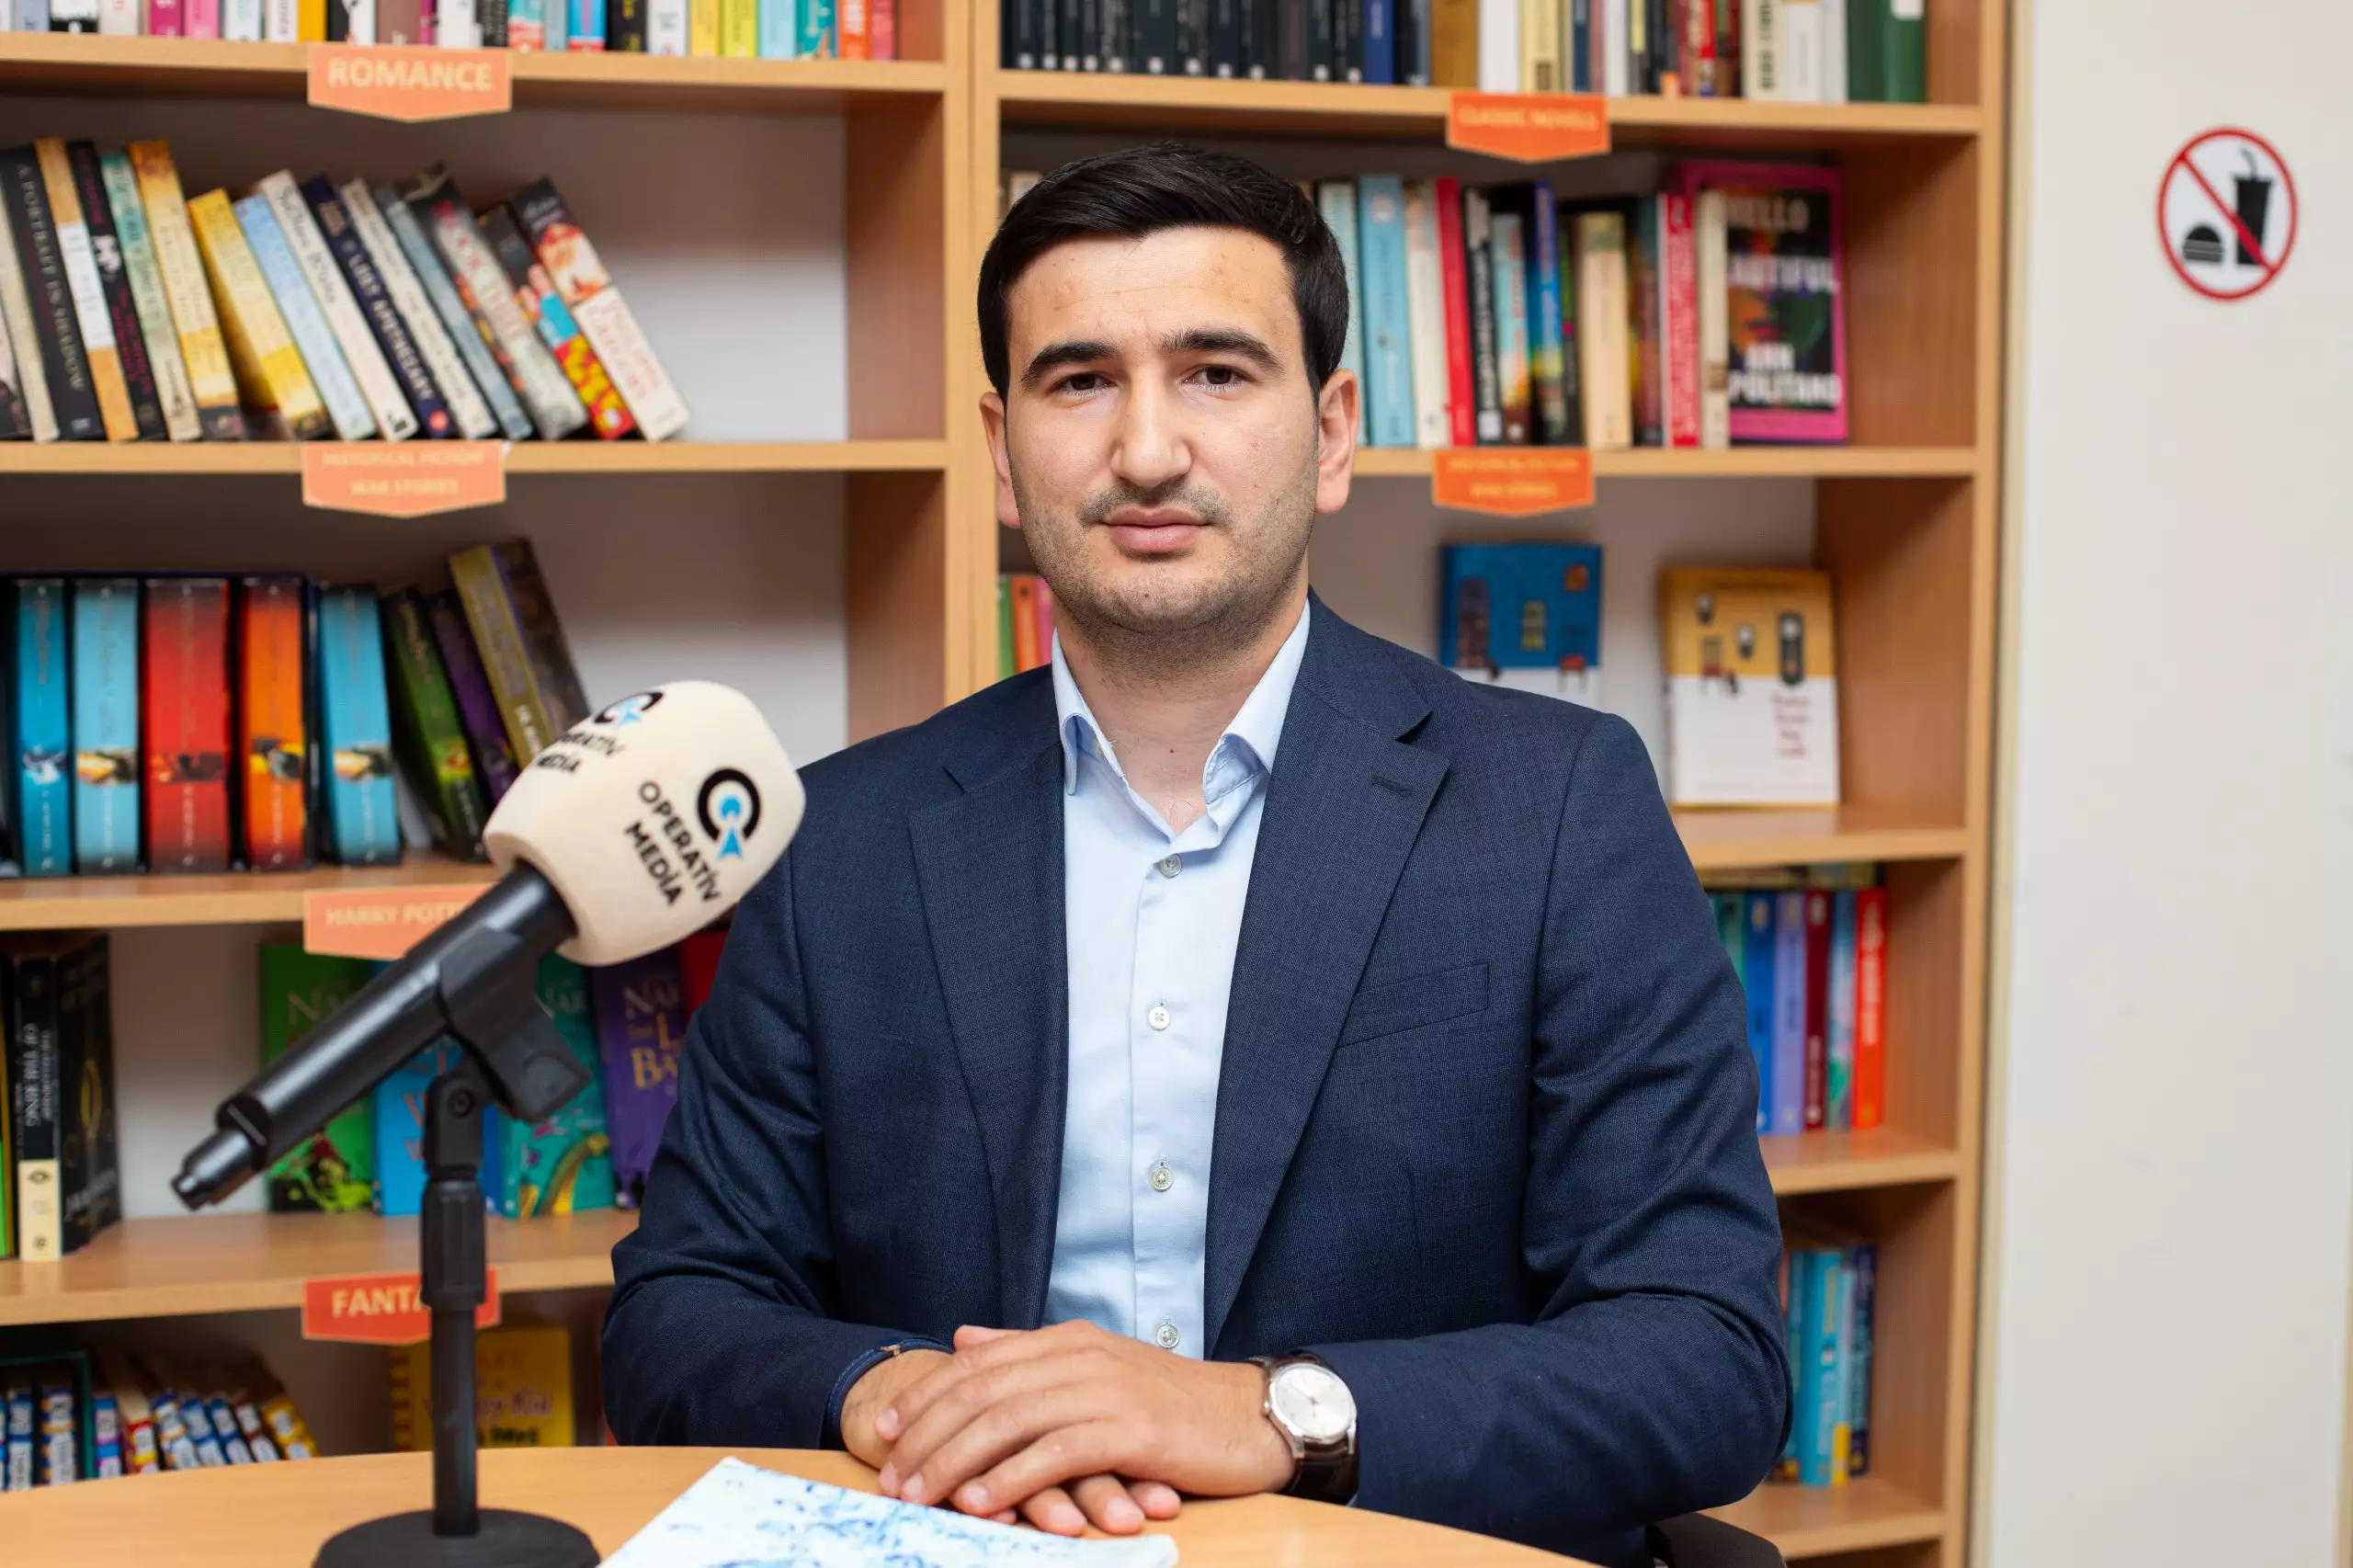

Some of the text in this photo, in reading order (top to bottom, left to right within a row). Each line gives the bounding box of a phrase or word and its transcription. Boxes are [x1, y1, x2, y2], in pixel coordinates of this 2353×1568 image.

[327, 57, 493, 91] ROMANCE
[326, 901, 465, 927] HARRY POTT
[332, 1285, 425, 1318] FANT
